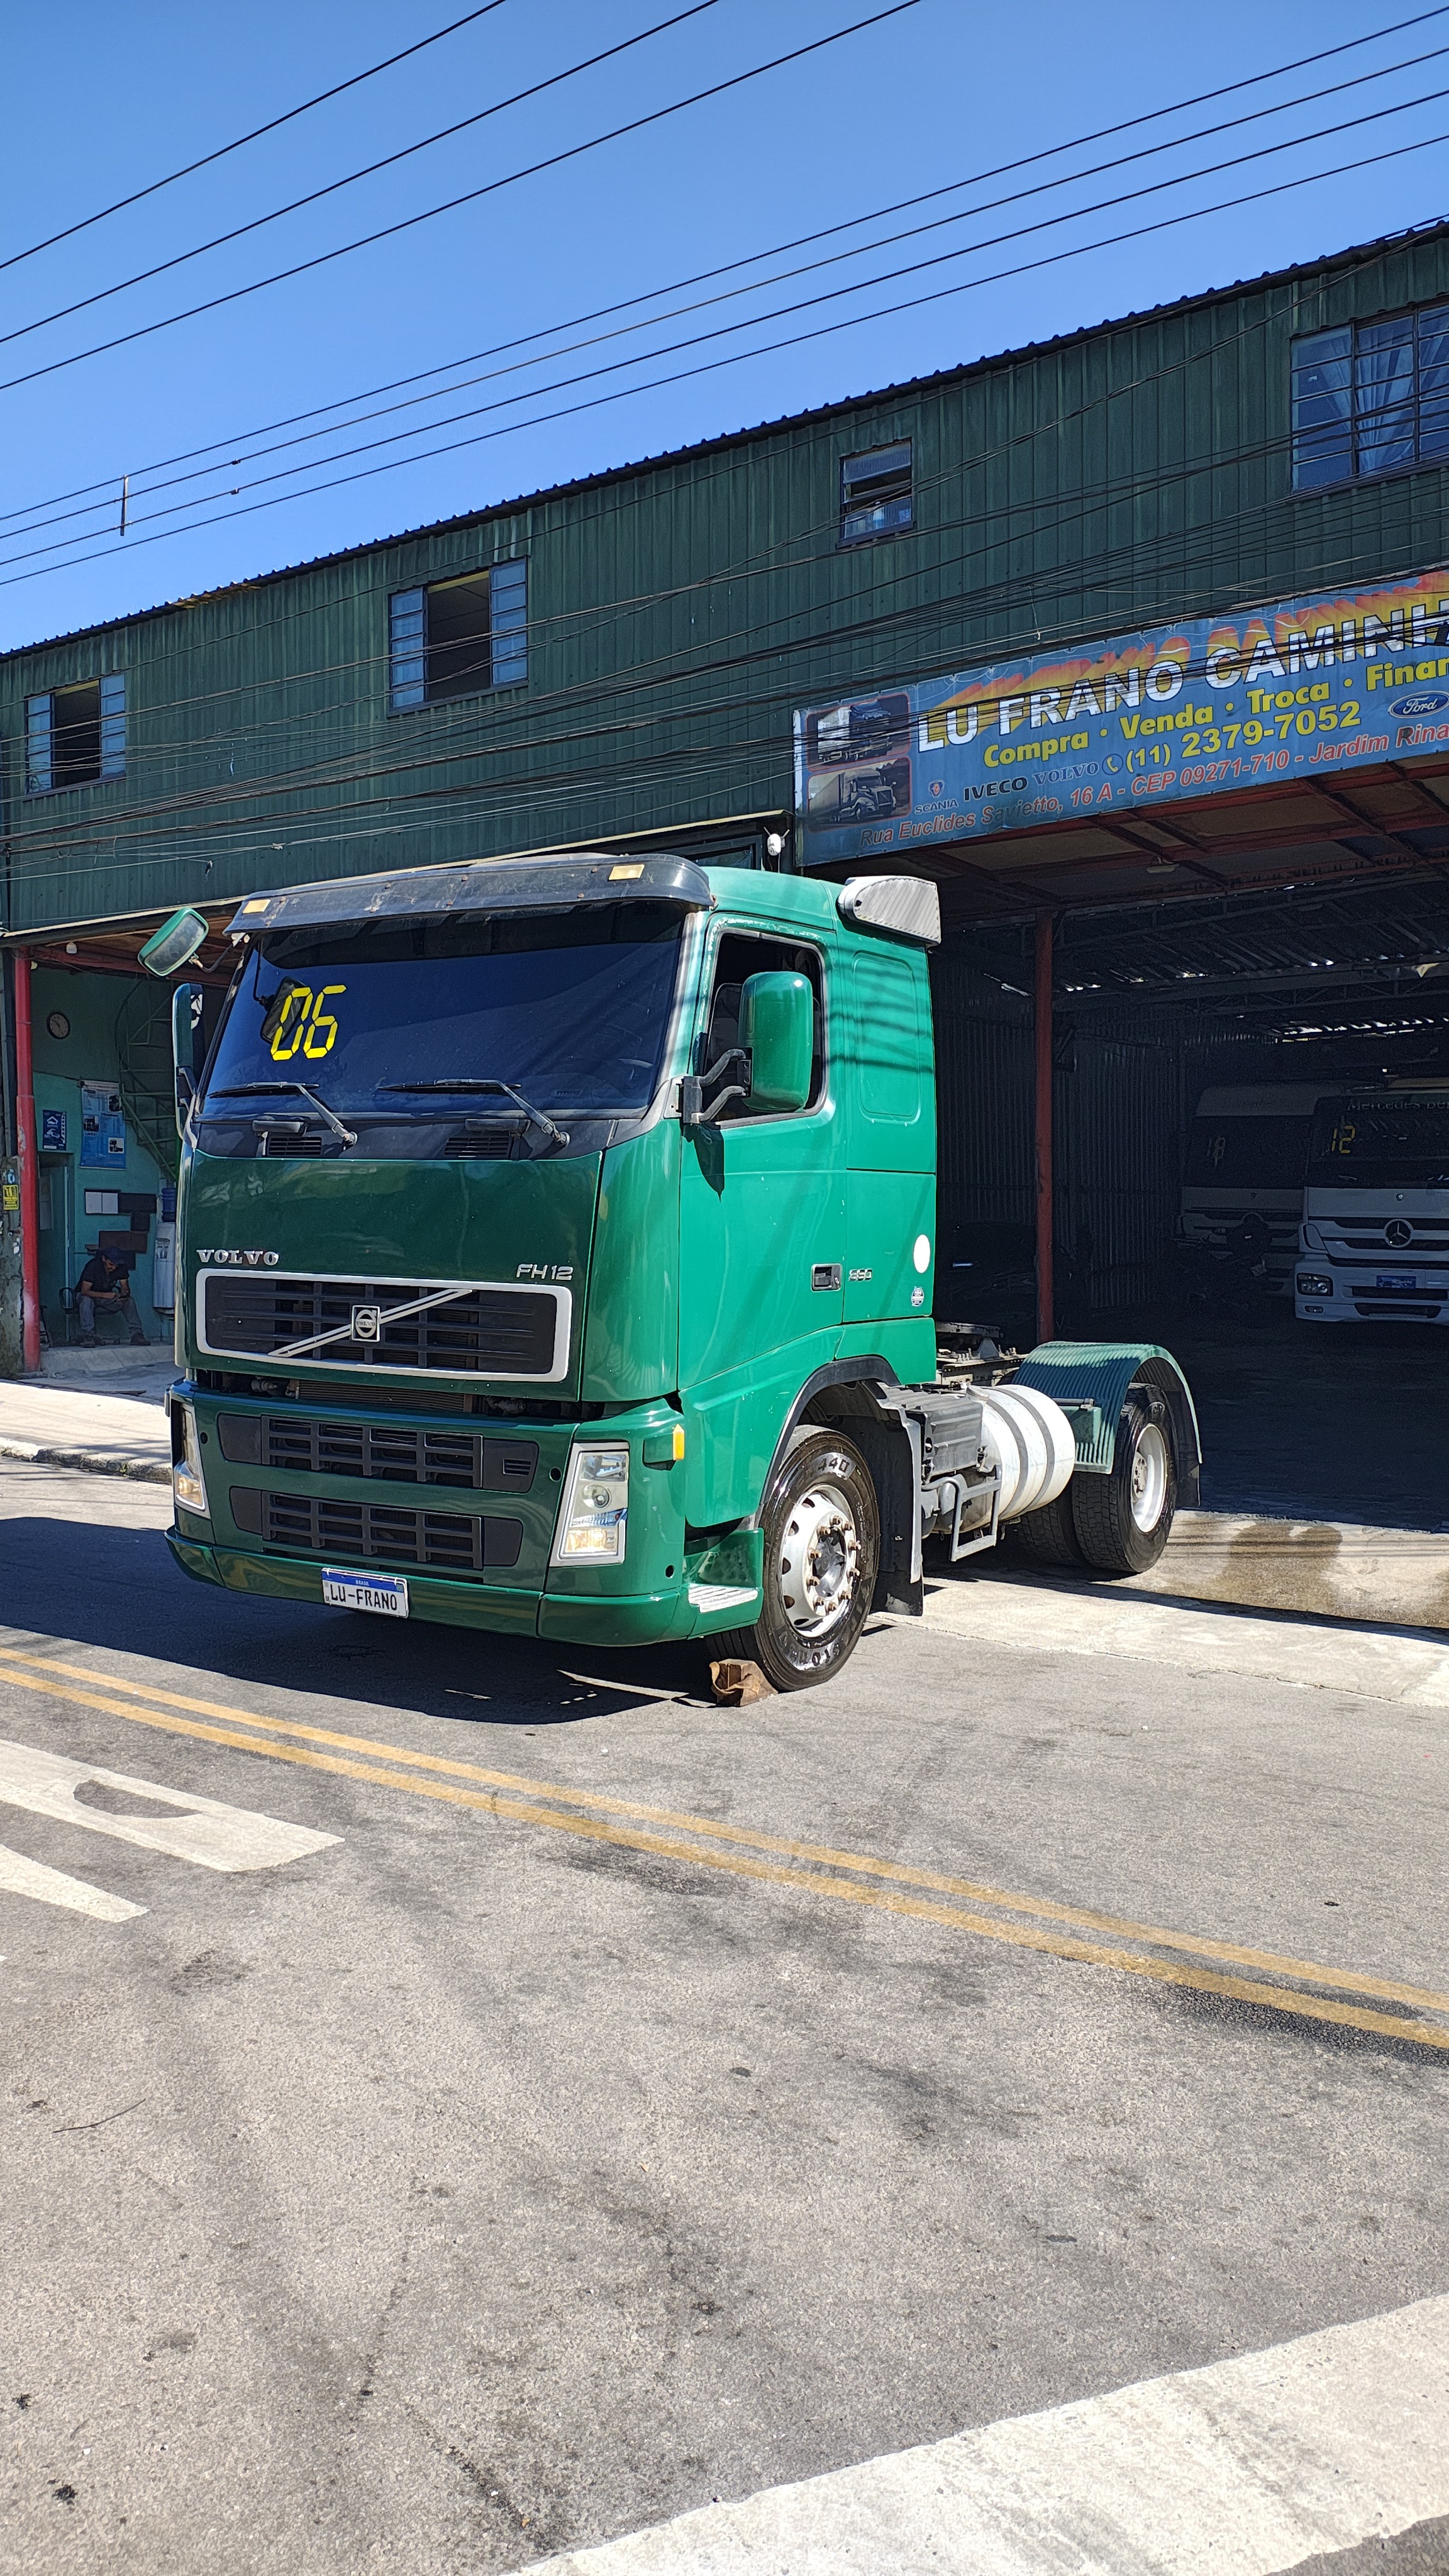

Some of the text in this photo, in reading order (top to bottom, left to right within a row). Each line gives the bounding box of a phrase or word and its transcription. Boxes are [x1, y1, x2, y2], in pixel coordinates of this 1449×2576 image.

[917, 704, 978, 753] LU
[999, 660, 1184, 736] FRANO
[1402, 696, 1439, 715] Ford
[983, 731, 1089, 769] Compra
[1119, 702, 1214, 740] Venda
[1246, 682, 1330, 715] Troca
[1126, 700, 1362, 774] (11) 2379-7052
[1032, 761, 1099, 785] VOLVO
[859, 828, 894, 848] Rua
[898, 812, 977, 840] Euclides
[1070, 786, 1093, 808] 16
[1097, 783, 1113, 804] A
[1131, 770, 1176, 797] CEP
[1179, 749, 1290, 787] 09271-710
[1308, 733, 1390, 764] Jardim
[963, 777, 1028, 802] IVECO
[914, 798, 959, 815] SCANIA
[270, 984, 347, 1062] 06
[1331, 1124, 1357, 1154] 12
[196, 1249, 279, 1266] VOLVO
[330, 1584, 397, 1611] LU-FRANO
